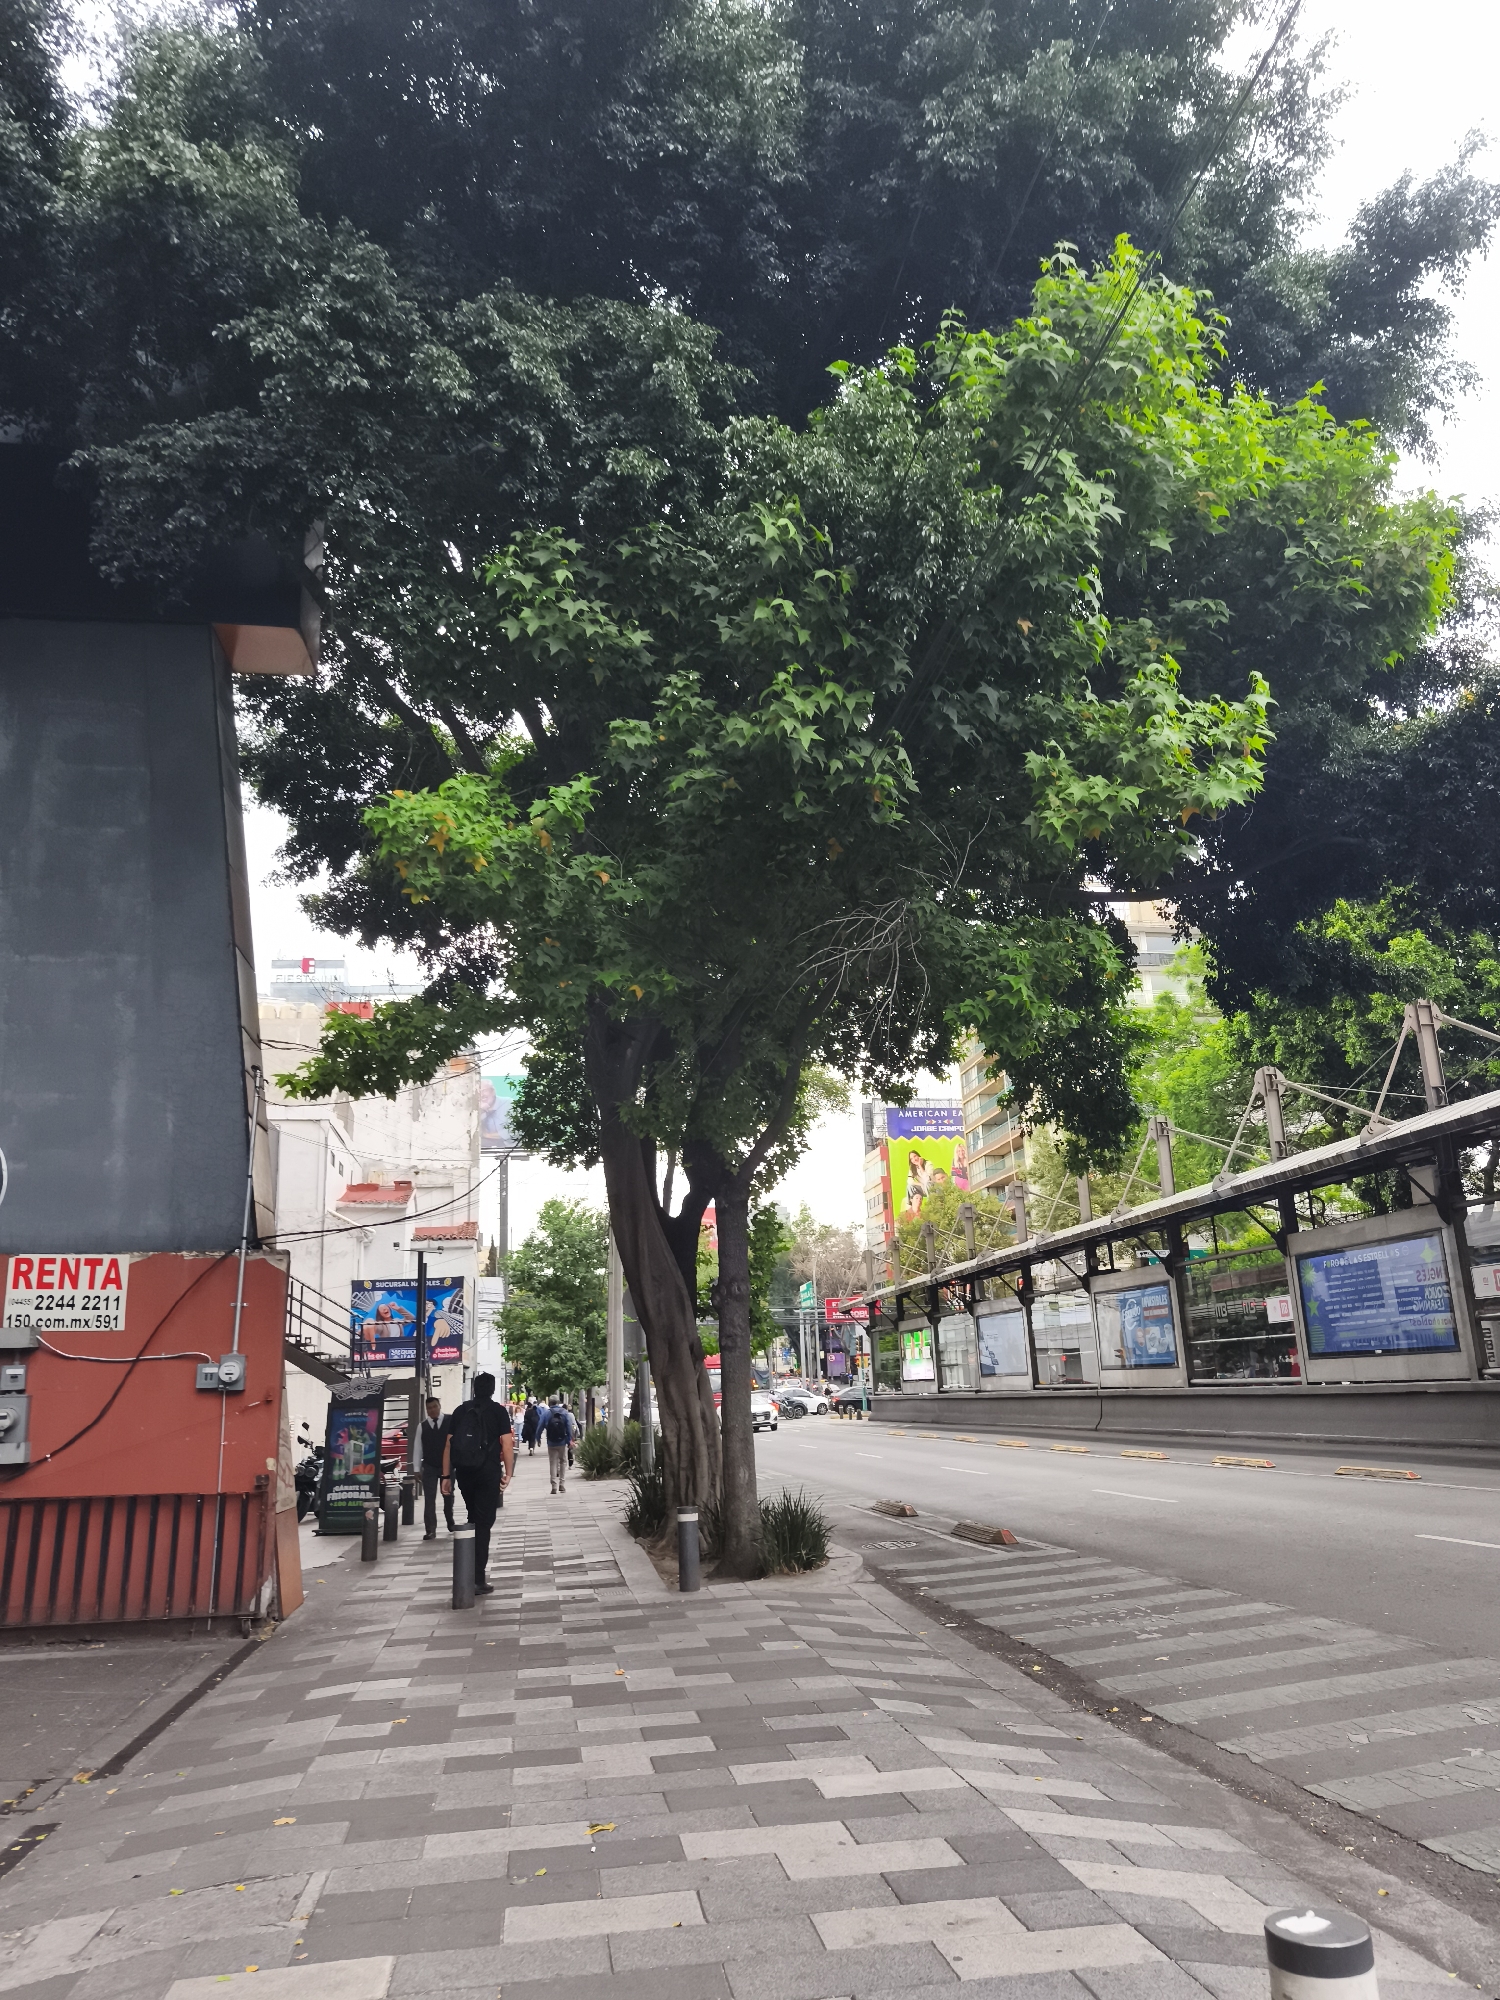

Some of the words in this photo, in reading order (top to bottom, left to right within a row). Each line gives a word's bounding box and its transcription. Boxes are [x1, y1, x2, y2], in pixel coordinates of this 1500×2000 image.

[898, 1110, 948, 1118] AMERICAN
[12, 1257, 123, 1290] RENTA
[34, 1294, 76, 1311] 2244
[81, 1295, 120, 1311] 2211
[6, 1314, 119, 1329] 150.com.mx/591
[432, 1375, 442, 1387] 5
